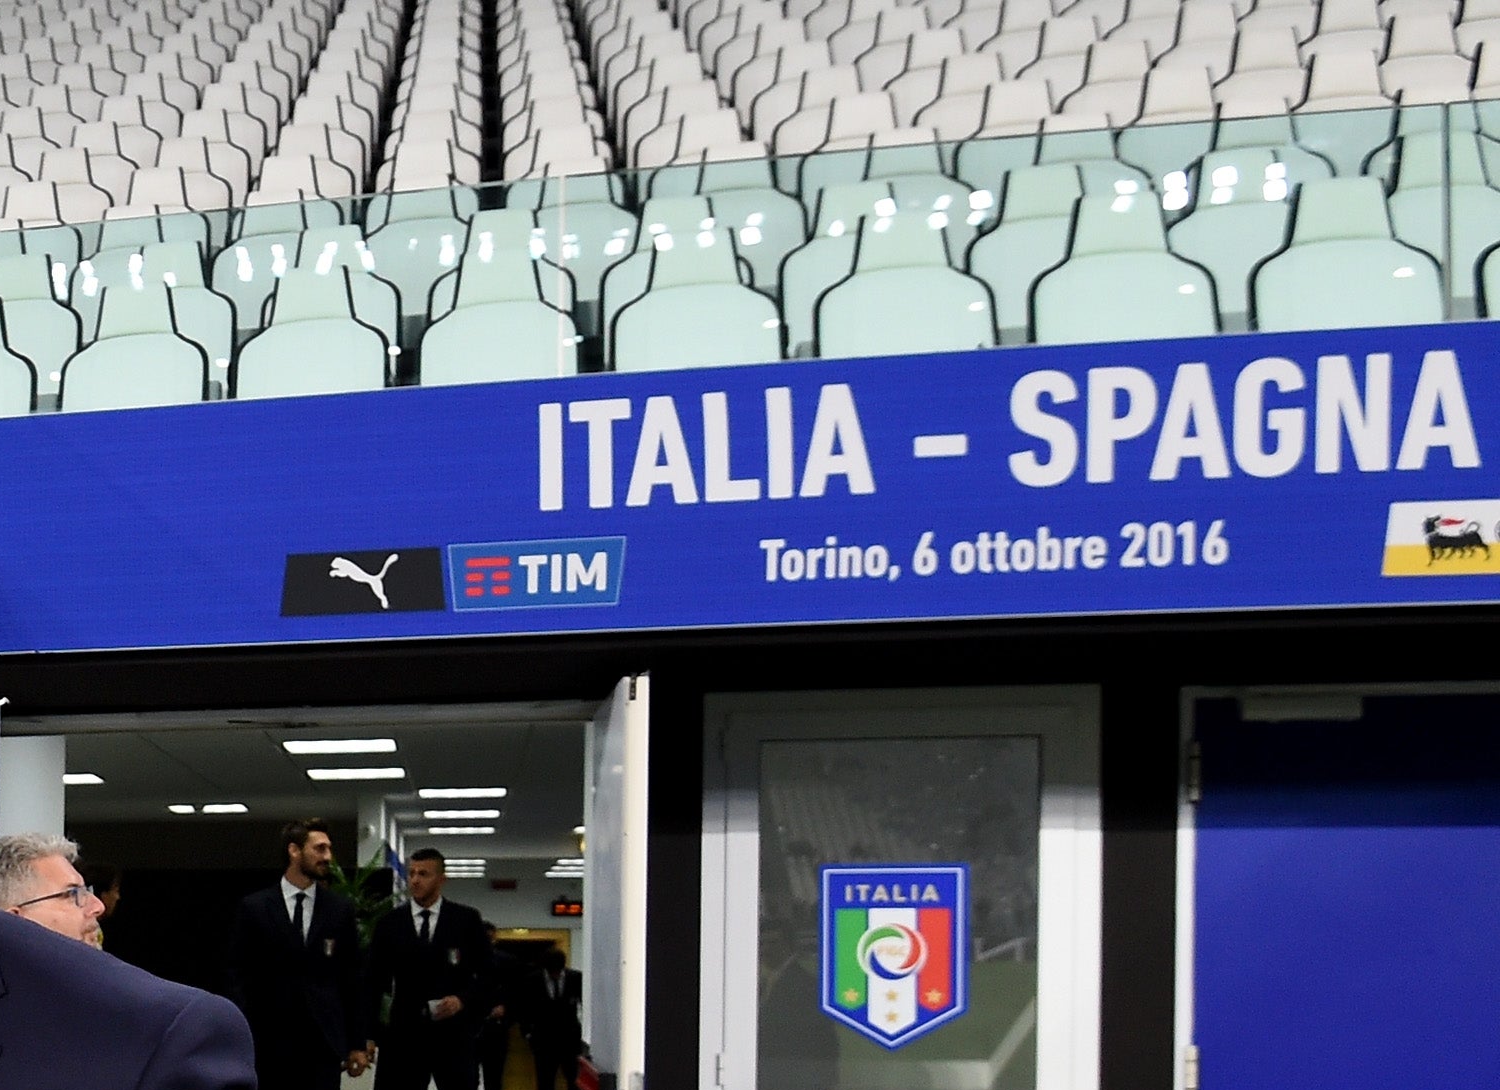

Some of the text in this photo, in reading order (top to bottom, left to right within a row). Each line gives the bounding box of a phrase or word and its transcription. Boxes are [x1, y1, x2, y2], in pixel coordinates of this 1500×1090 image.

[538, 349, 1482, 511] ITALIA - SPAGNA
[518, 551, 607, 594] TIM
[759, 520, 1229, 583] Torino, 6 ottobre 2016
[844, 883, 940, 902] ITALIA
